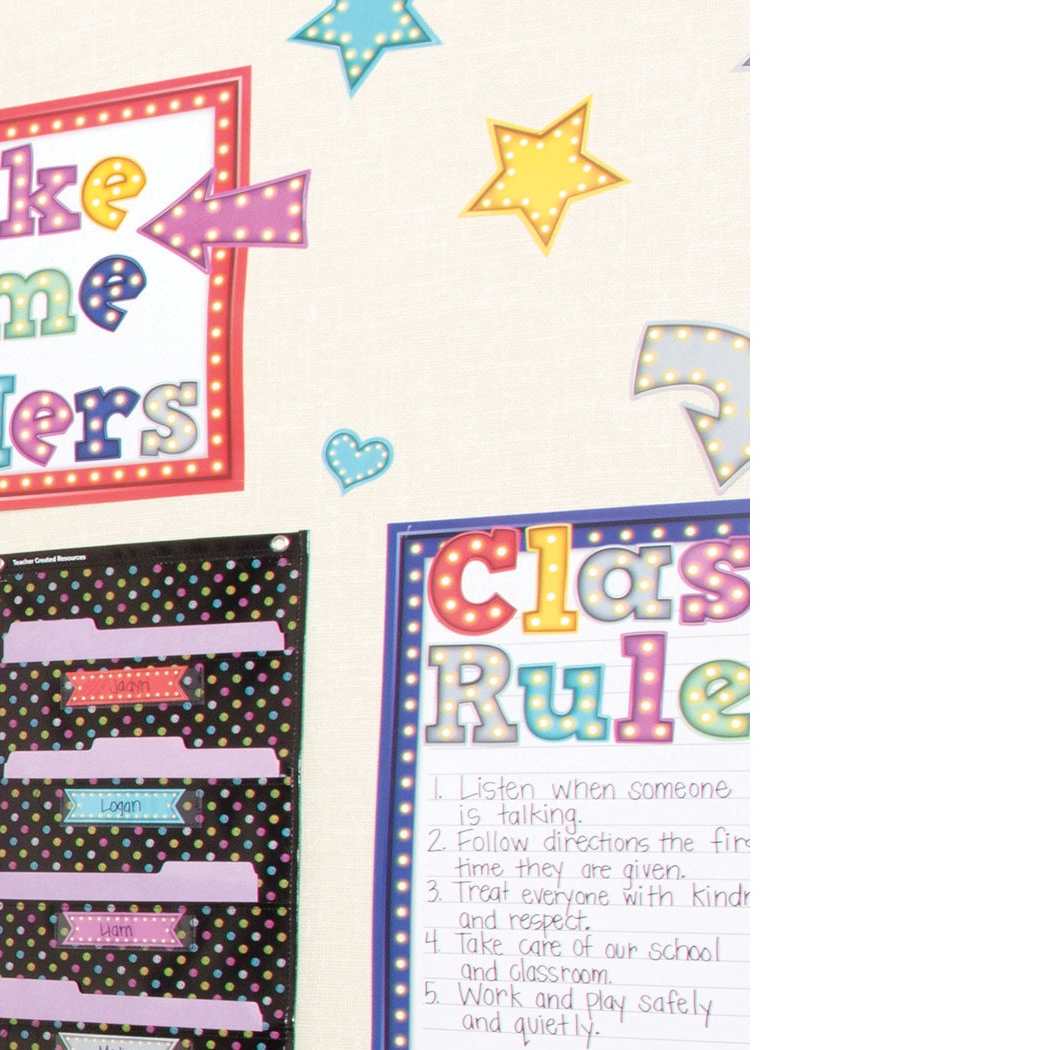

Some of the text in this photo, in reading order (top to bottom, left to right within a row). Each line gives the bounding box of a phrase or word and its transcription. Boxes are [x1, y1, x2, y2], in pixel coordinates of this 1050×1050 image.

[425, 631, 750, 744] Rule
[460, 774, 534, 800] Listen
[551, 778, 615, 801] when
[628, 779, 732, 800] someone
[100, 799, 141, 817] Logan
[459, 803, 583, 835] is talking.
[427, 828, 446, 853] 2.
[457, 829, 529, 852] Follow
[543, 829, 650, 853] directions
[658, 828, 694, 852] the
[454, 858, 686, 890] time they are given.
[426, 879, 442, 902] 3.
[452, 881, 510, 903] Treat
[521, 886, 610, 917] everyone
[623, 885, 674, 907] with
[100, 922, 133, 938] Liam
[459, 909, 591, 938] and respect.
[425, 929, 441, 954] 4.
[454, 932, 504, 957] Take
[519, 937, 561, 957] care
[605, 941, 638, 959] our
[649, 936, 720, 962] school
[460, 959, 613, 985] and classroom.
[425, 981, 712, 1028] 5. Work and play safely
[463, 1011, 600, 1049] and quietly.
